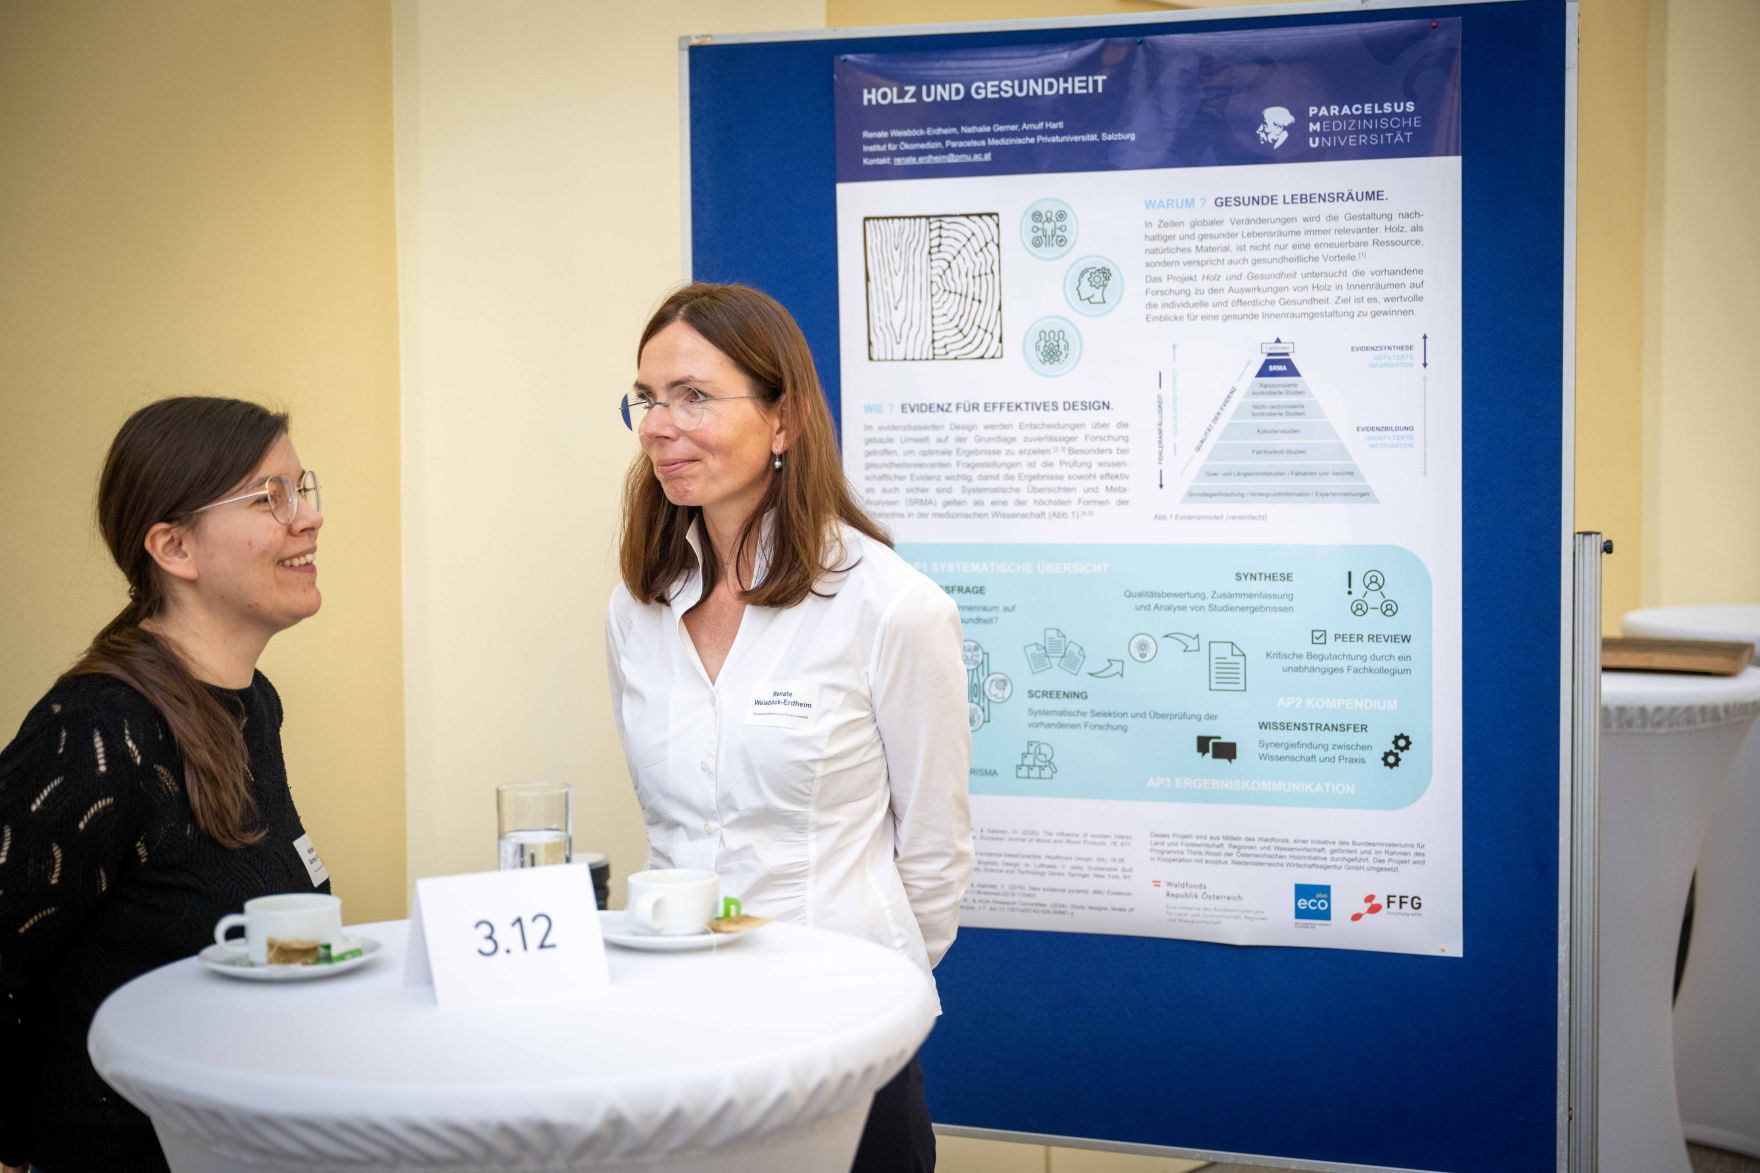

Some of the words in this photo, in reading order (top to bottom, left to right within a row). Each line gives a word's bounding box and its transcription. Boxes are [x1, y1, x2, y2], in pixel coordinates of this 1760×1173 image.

[862, 85, 917, 105] HOLZ
[921, 83, 965, 102] UND
[969, 76, 1107, 100] GESUNDHEIT
[1308, 101, 1414, 116] PARACELSUS
[1308, 116, 1421, 132] MEDIZINISCHE
[1308, 131, 1412, 148] UNIVERSITÄT
[1143, 197, 1195, 210] WARUM
[1213, 194, 1278, 207] GESUNDE
[1282, 188, 1388, 205] LEBENSRÄUME.
[1144, 219, 1152, 229] In
[1156, 218, 1185, 228] Zeiten
[1188, 216, 1224, 229] globaler
[1228, 215, 1297, 226] Veränderungen
[1301, 212, 1320, 223] wird
[1325, 212, 1339, 222] die
[1343, 210, 1392, 222] Gestaltung
[1397, 209, 1424, 219] nach-
[1143, 231, 1176, 243] haltiger
[1178, 230, 1196, 240] und
[1197, 229, 1239, 242] gesunder
[1240, 228, 1302, 238] Lebensräume
[1303, 227, 1332, 236] immer
[1384, 224, 1407, 235] Holz,
[1409, 223, 1424, 233] als
[1144, 244, 1192, 255] natürliches
[1235, 242, 1246, 252] ist
[1249, 241, 1271, 252] nicht
[1273, 243, 1289, 251] nur
[1291, 240, 1311, 250] eine
[1313, 239, 1369, 249] erneuerbare
[1372, 238, 1424, 248] Ressource,
[1144, 258, 1180, 268] sondern
[1182, 256, 1225, 268] verspricht
[1226, 255, 1249, 265] auch
[1250, 253, 1320, 267] gesundheitliche
[1144, 274, 1163, 283] Das
[1166, 272, 1197, 285] Projekt
[1201, 272, 1221, 282] Holz
[1225, 271, 1242, 281] und
[1246, 269, 1297, 280] Gesundheit
[1300, 268, 1348, 279] untersucht
[1351, 268, 1365, 277] die
[1369, 266, 1424, 277] vorhandene
[1144, 286, 1191, 298] Forschung
[1194, 287, 1204, 295] zu
[1207, 285, 1224, 295] den
[1227, 284, 1289, 295] Auswirkungen
[1311, 282, 1332, 292] Holz
[1334, 282, 1343, 291] in
[1346, 280, 1406, 291] Innenräumen
[1409, 279, 1424, 289] auf
[1144, 300, 1158, 309] die
[1160, 298, 1210, 309] individuelle
[1211, 298, 1228, 308] und
[1230, 296, 1276, 307] öffentliche
[1334, 294, 1351, 304] Ziel
[1353, 294, 1364, 304] ist
[1366, 296, 1380, 305] es,
[1383, 293, 1424, 303] wertvolle
[1145, 312, 1184, 322] Einblicke
[1186, 312, 1198, 321] für
[1200, 311, 1219, 321] eine
[1221, 310, 1259, 323] gesunde
[1261, 308, 1354, 321] Innenraumgestaltung
[1369, 307, 1416, 319] gewinnen.
[900, 402, 952, 413] EVIDENZ
[954, 399, 980, 413] FÜR
[982, 401, 1059, 412] EFFEKTIVES
[1061, 400, 1113, 411] DESIGN.
[1235, 572, 1293, 582] SYNTHESE
[940, 584, 986, 595] SFRAGE
[1123, 590, 1208, 601] Qualitätsbewertung,
[1210, 591, 1294, 602] Zusammenfassung
[1002, 604, 1016, 612] auf
[1134, 603, 1151, 611] und
[1152, 603, 1187, 614] Analyse
[1207, 603, 1294, 615] Studienergebnissen
[1333, 633, 1364, 643] PEER
[1366, 633, 1411, 643] REVIEW
[1265, 651, 1304, 660] Kritische
[1305, 652, 1367, 663] Begutachtung
[1369, 652, 1395, 661] durch
[1397, 653, 1411, 662] ein
[1281, 664, 1344, 676] unabhängiges
[1346, 665, 1411, 677] Fachkollegium
[1027, 690, 1088, 699] SCREENING
[1276, 697, 1302, 708] AP2
[1305, 698, 1398, 710] KOMPENDIUM
[1027, 708, 1087, 718] Systematische
[1089, 709, 1128, 718] Selektion
[1129, 711, 1146, 719] und
[1148, 709, 1201, 722] Überprüfung
[1203, 712, 1218, 721] der
[1027, 721, 1081, 730] vorhandenen
[1083, 722, 1127, 733] Forschung
[1257, 722, 1367, 733] WISSENSTRANSFER
[1257, 740, 1329, 752] Synergiefindung
[1330, 742, 1372, 751] zwischen
[1257, 753, 1316, 763] Wissenschaft
[1318, 755, 1335, 763] und
[1337, 755, 1366, 764] Praxis
[970, 767, 999, 777] RISMA
[1147, 777, 1172, 788] AP3
[1174, 778, 1355, 794] ERGEBNISKOMMUNIKATION
[1297, 898, 1329, 911] eco
[1386, 894, 1422, 911] FFG
[474, 913, 557, 957] 3.12
